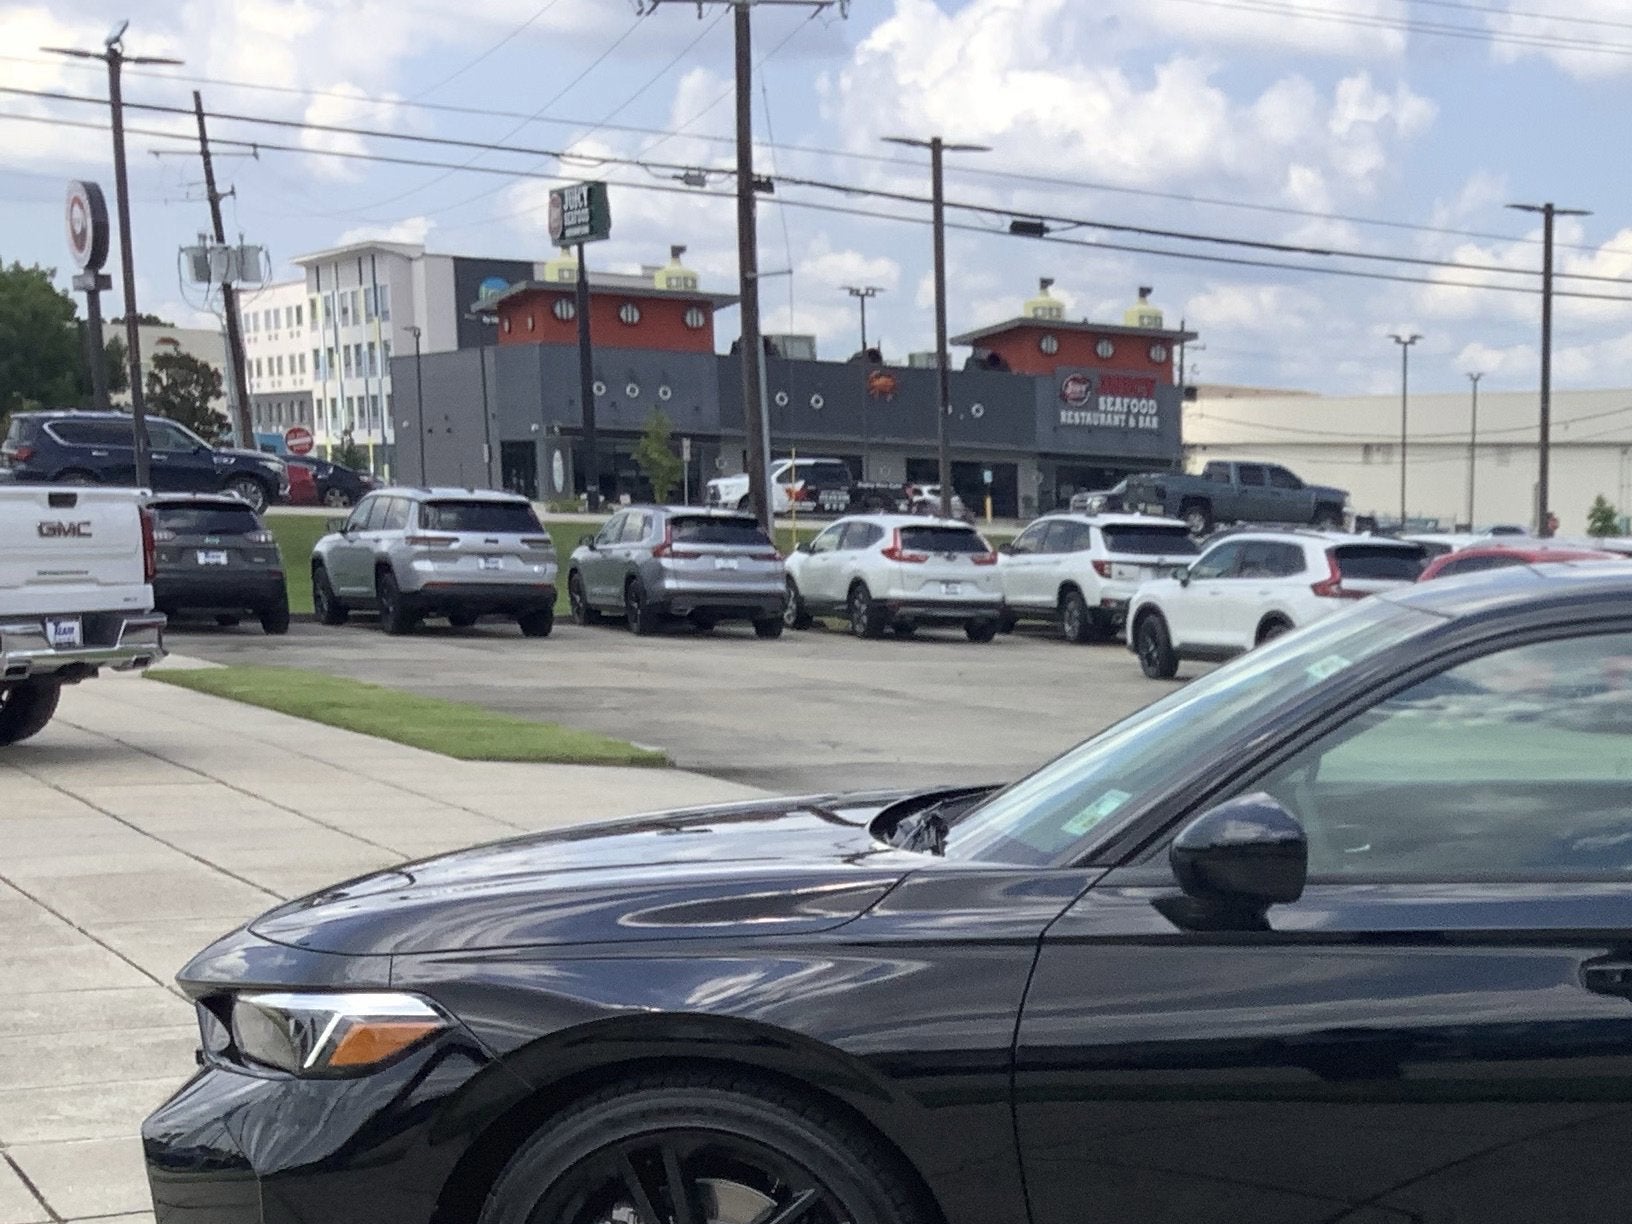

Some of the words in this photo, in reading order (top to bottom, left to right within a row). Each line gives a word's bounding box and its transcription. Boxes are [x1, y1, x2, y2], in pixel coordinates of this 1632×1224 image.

[1098, 396, 1158, 415] SEAFOOD
[1060, 410, 1126, 427] RESTAURANT
[1138, 415, 1159, 429] BAR
[38, 521, 92, 538] GMC
